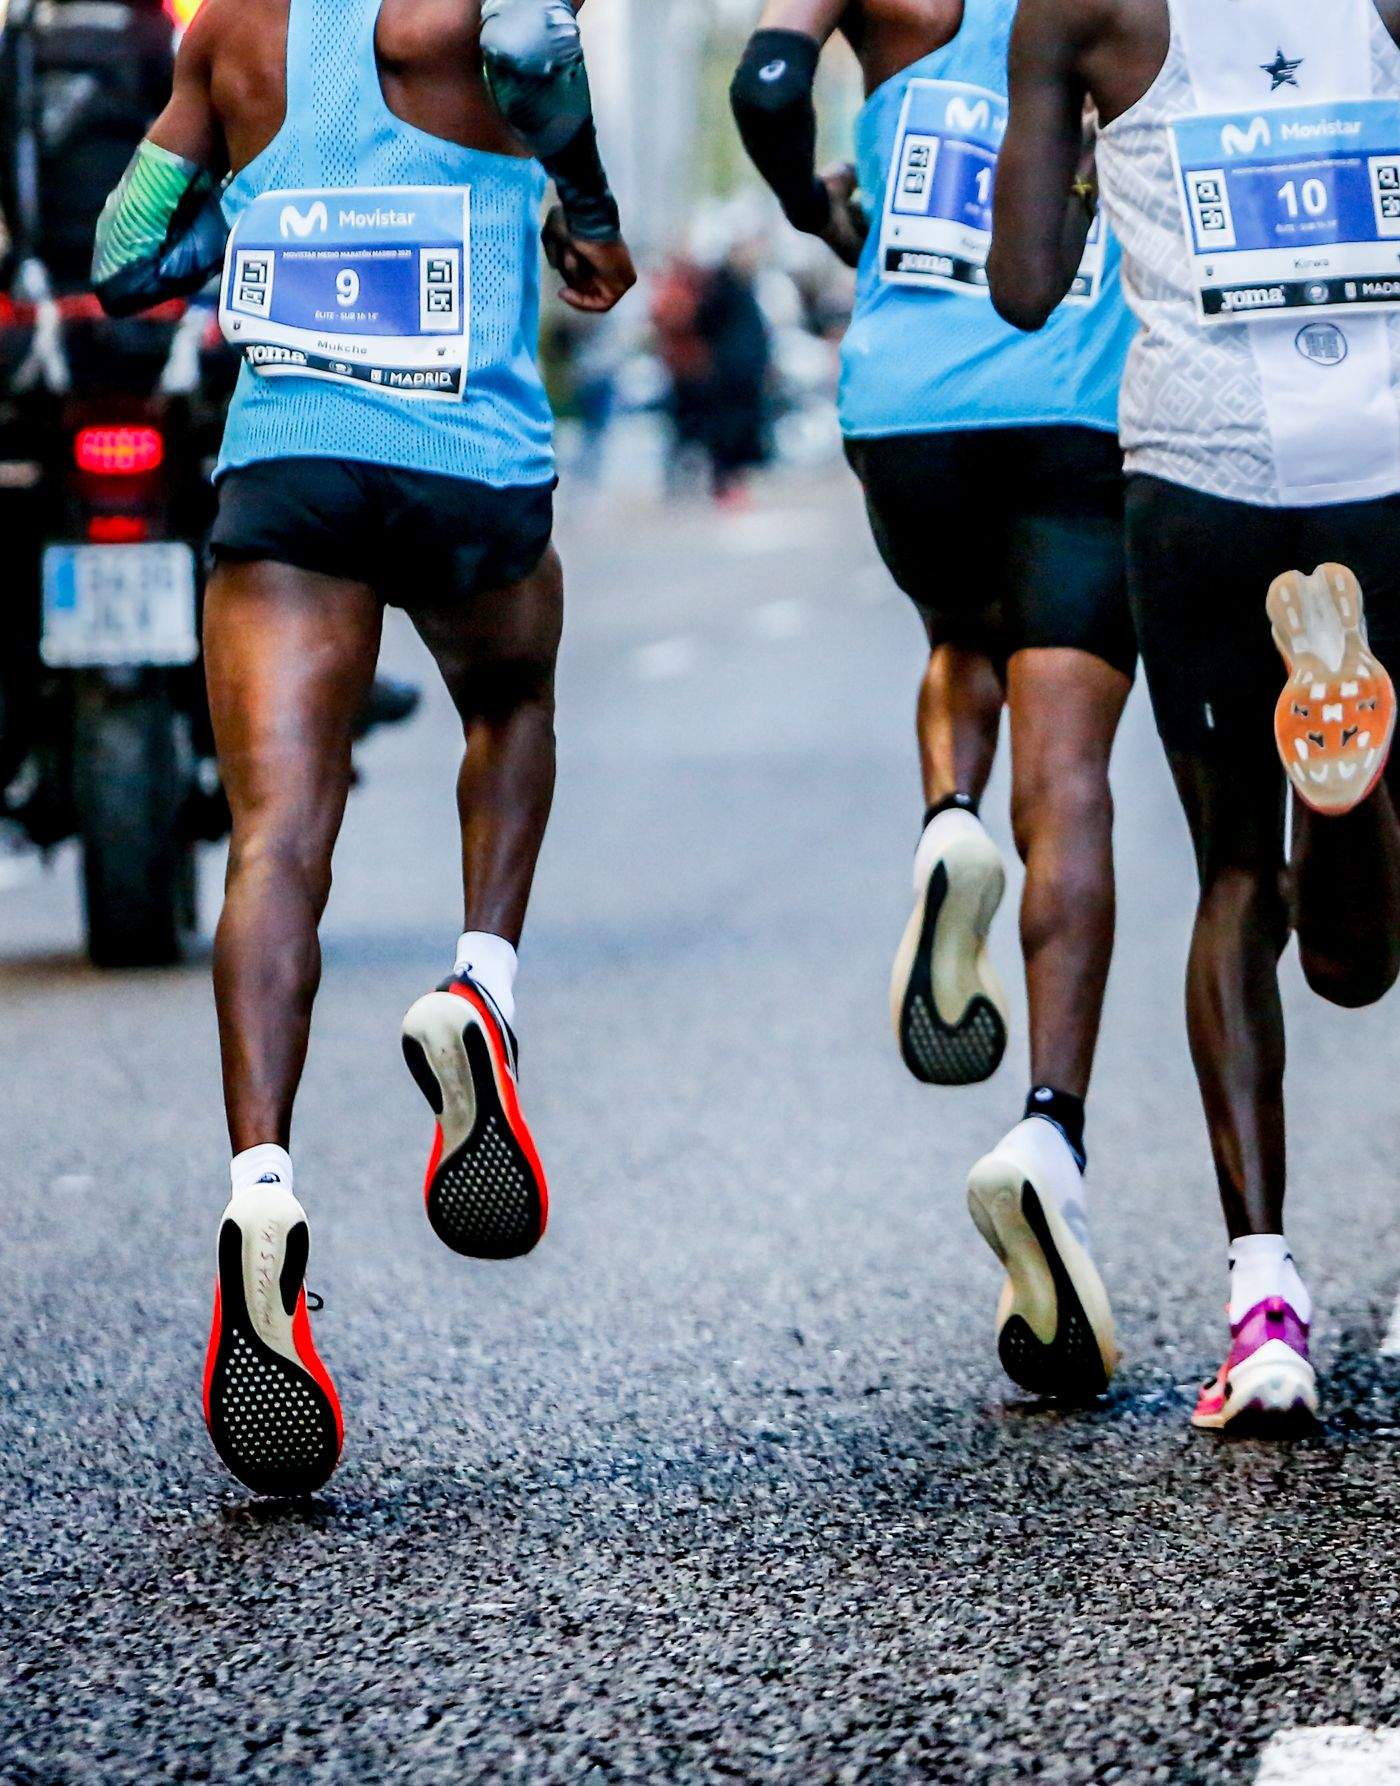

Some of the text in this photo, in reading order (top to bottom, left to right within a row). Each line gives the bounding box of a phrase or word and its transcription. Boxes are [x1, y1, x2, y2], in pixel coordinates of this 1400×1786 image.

[1281, 119, 1362, 141] Movistar
[1278, 178, 1328, 218] 10
[339, 208, 415, 229] Movistar
[336, 267, 360, 307] 9
[390, 371, 452, 386] MADRID
